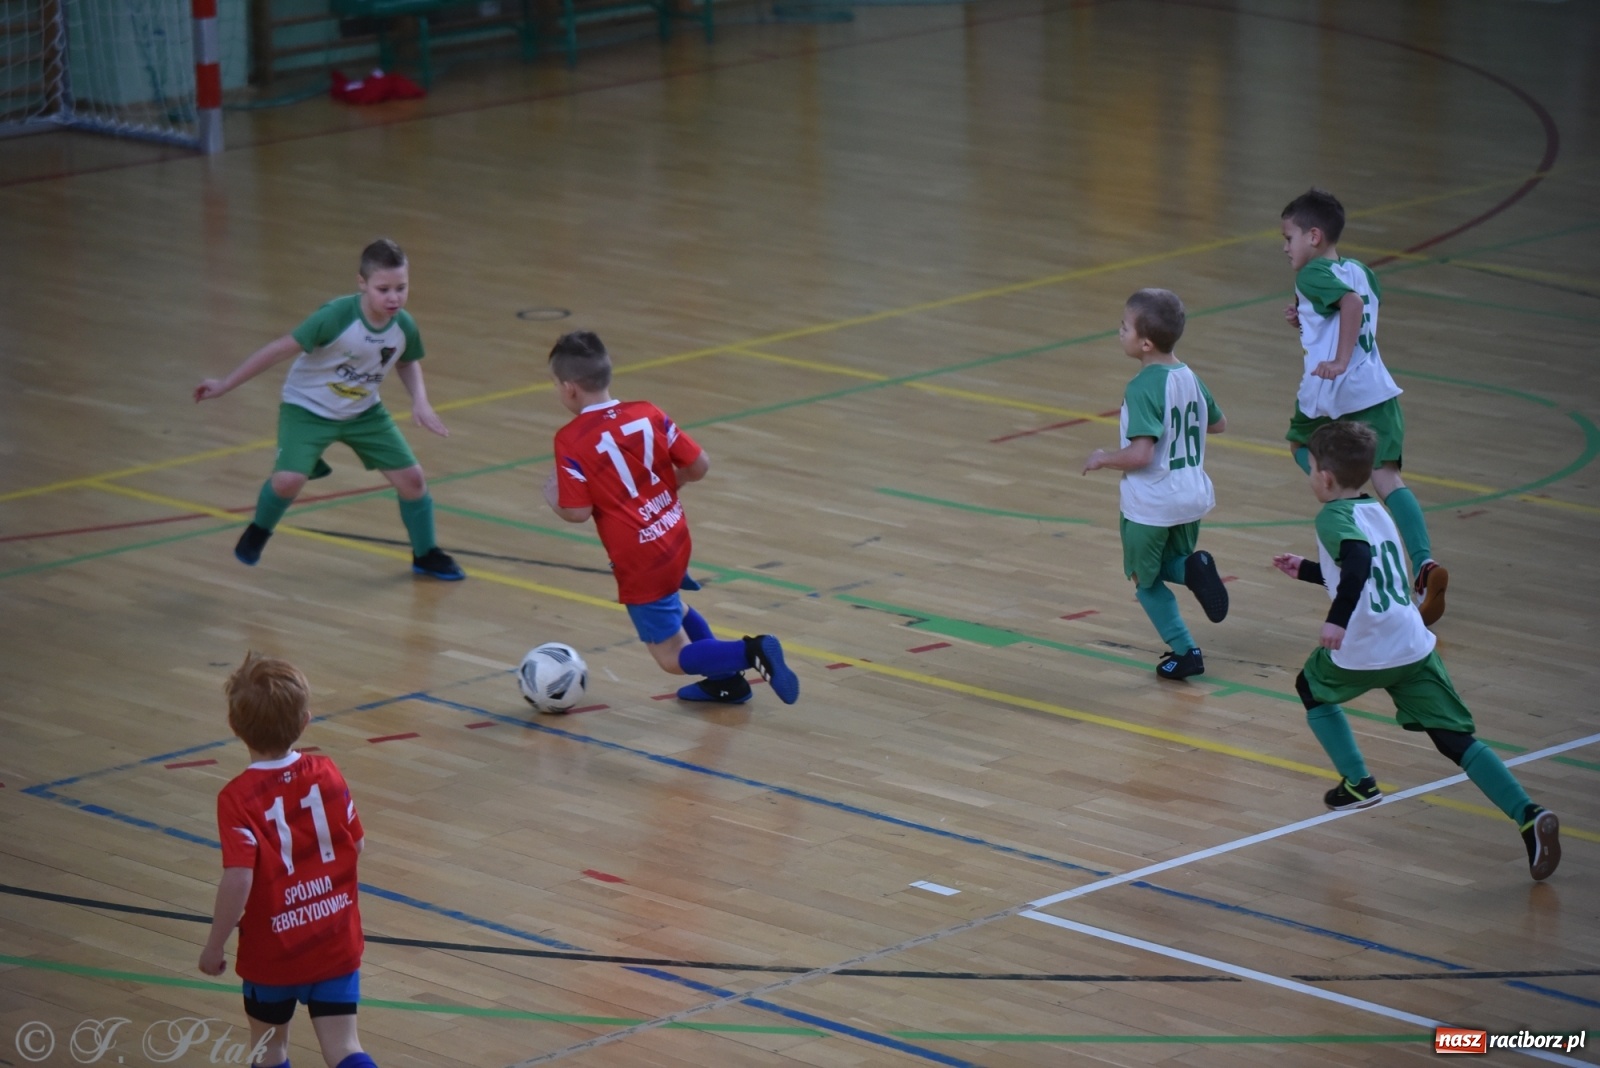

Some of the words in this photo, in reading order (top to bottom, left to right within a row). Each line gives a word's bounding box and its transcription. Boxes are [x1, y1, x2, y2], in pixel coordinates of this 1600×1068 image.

[595, 417, 660, 499] 17
[1169, 401, 1201, 471] 26
[1367, 541, 1411, 614] 50
[264, 783, 336, 876] 11
[284, 875, 333, 906] SPÓJNIA
